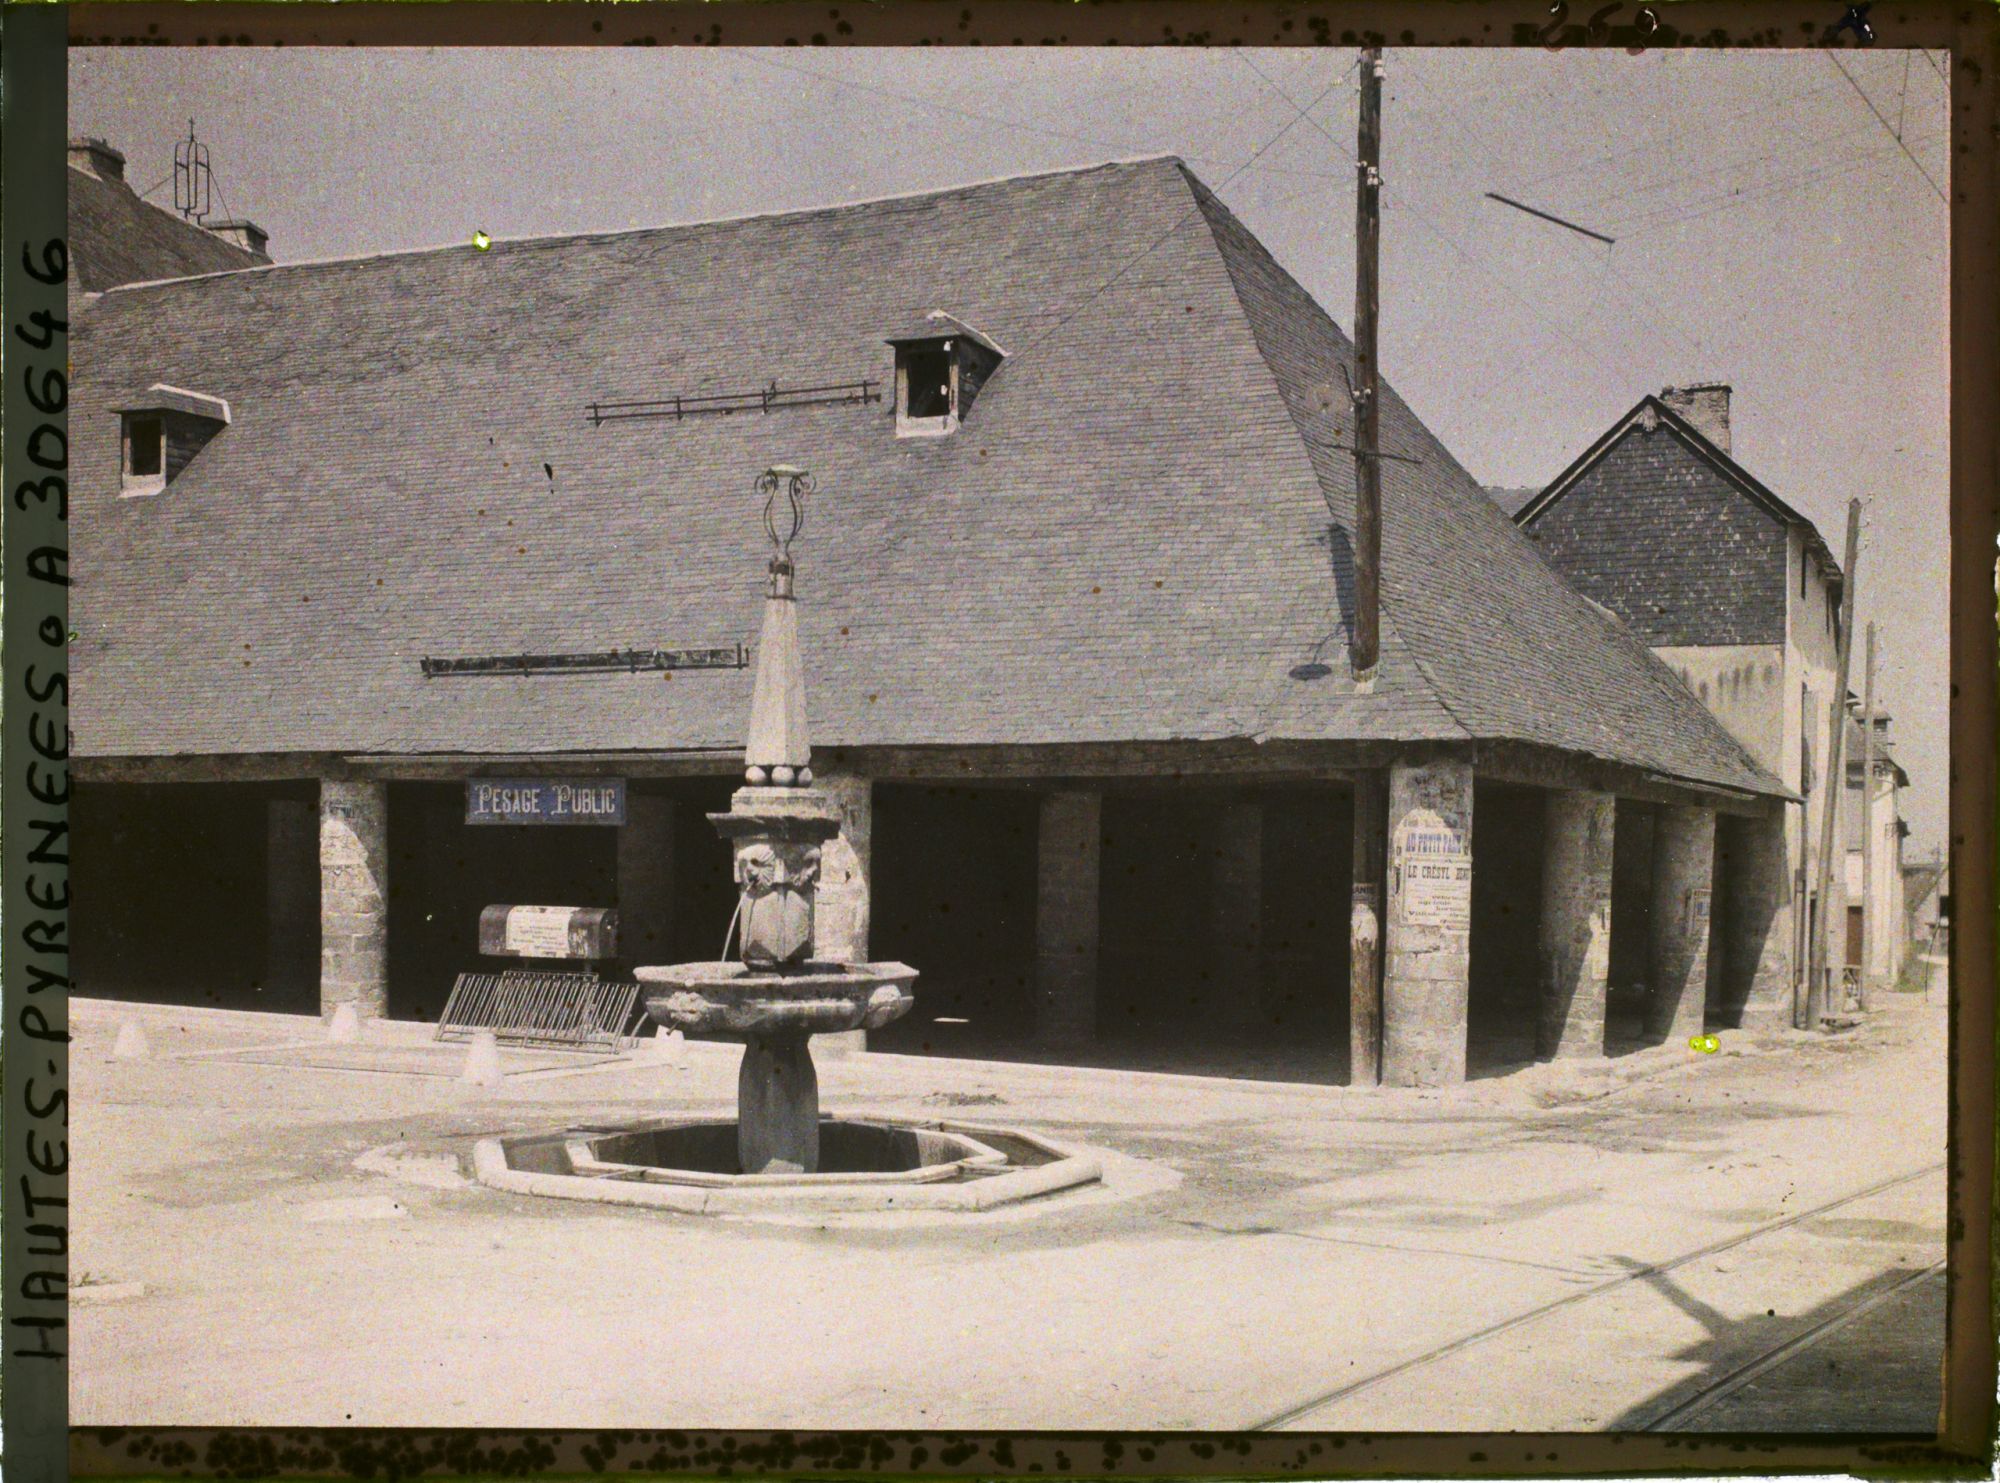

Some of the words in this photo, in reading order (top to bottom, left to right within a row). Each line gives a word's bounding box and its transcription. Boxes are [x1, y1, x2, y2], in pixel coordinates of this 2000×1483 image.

[474, 784, 541, 816] PESAGE
[551, 784, 616, 816] PUBLIC
[1408, 865, 1418, 879] LE
[1422, 863, 1451, 880] CRÉSYL
